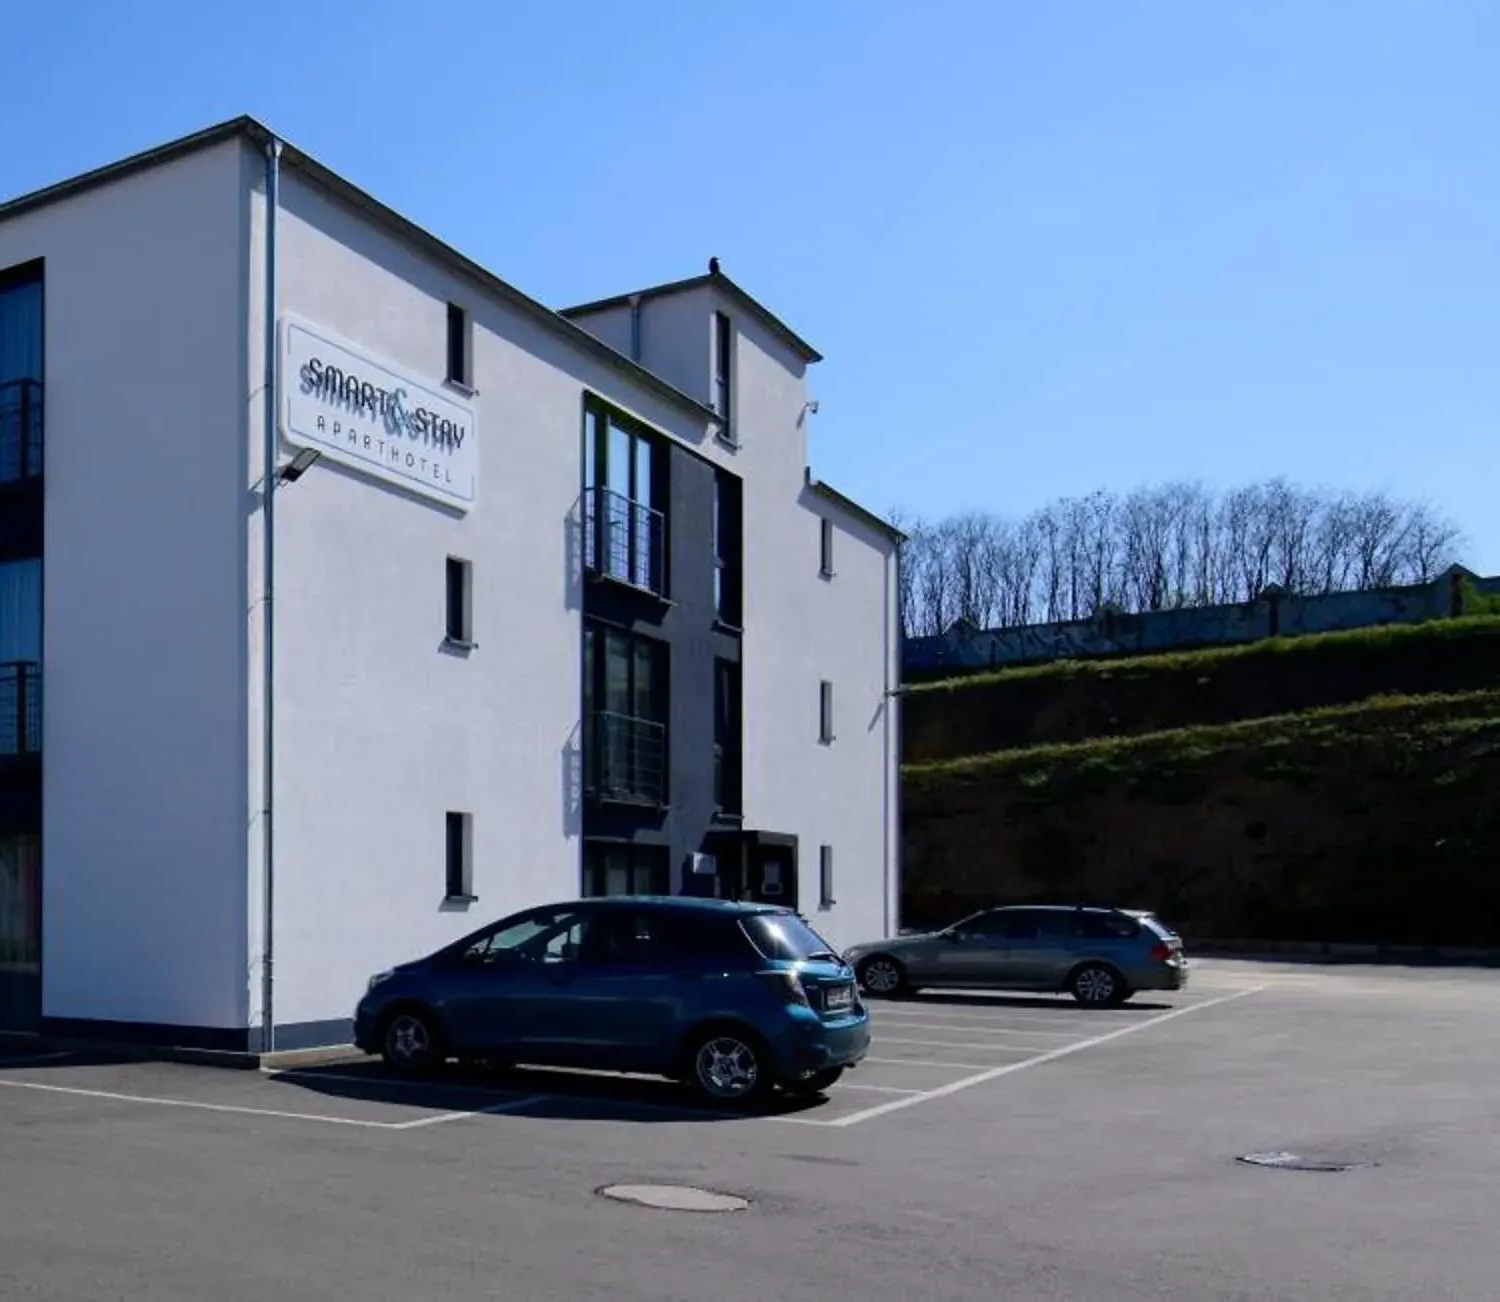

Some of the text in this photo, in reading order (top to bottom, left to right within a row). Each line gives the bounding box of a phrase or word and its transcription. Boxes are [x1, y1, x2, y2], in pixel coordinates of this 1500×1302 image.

[308, 357, 388, 416] SMART
[414, 407, 465, 449] STAY
[317, 415, 452, 483] APARTHOTEL
